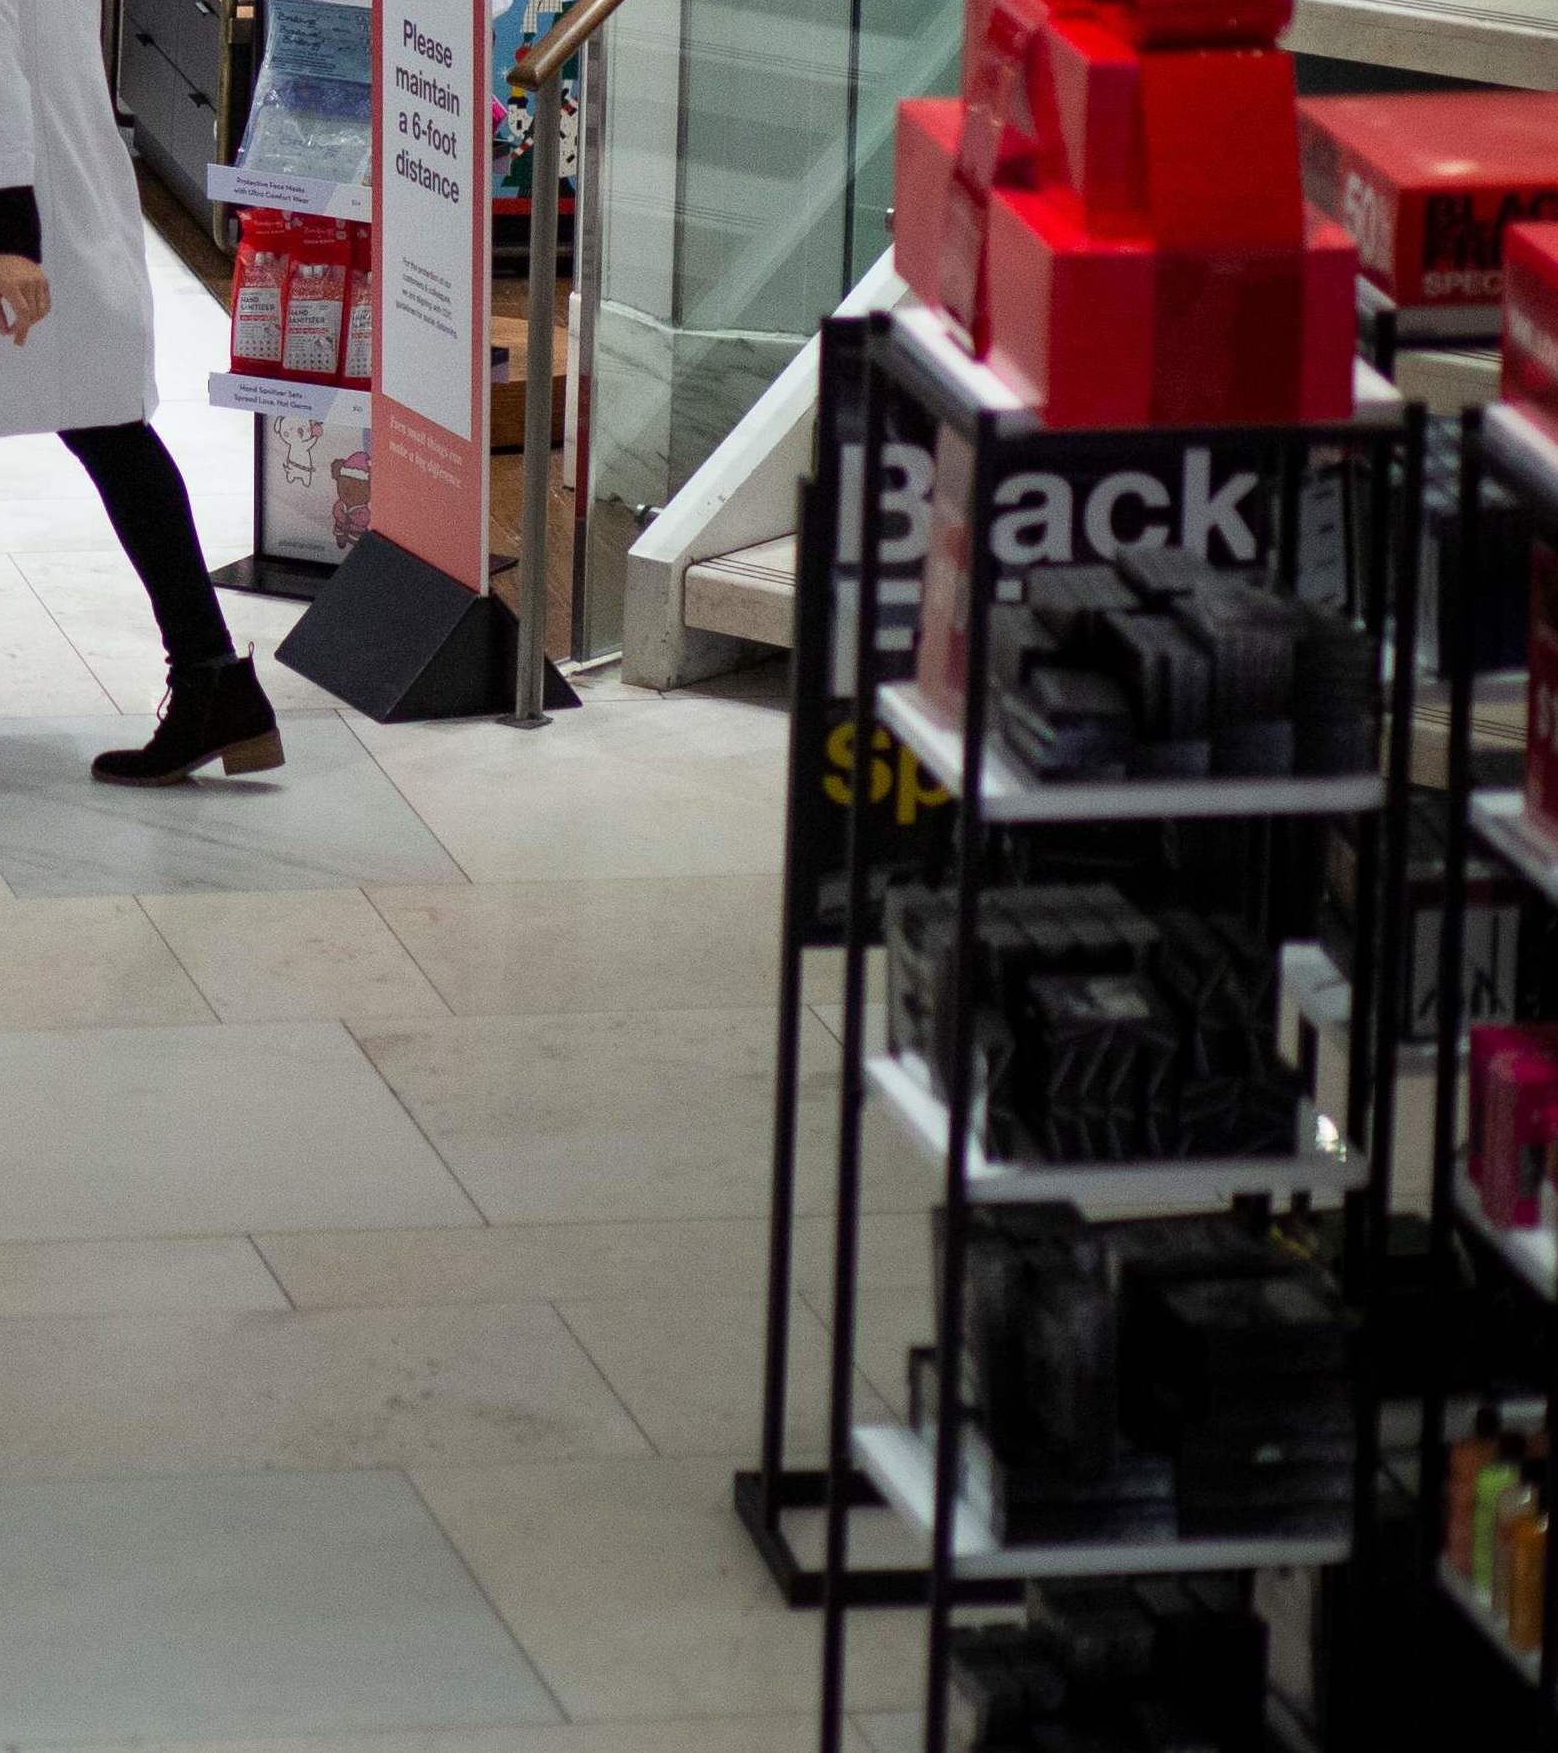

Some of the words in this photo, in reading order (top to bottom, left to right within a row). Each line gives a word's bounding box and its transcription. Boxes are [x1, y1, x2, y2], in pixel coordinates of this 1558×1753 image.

[403, 19, 452, 69] Please
[395, 65, 460, 117] maintain
[398, 111, 408, 135] a
[412, 111, 457, 160] 6-foot
[395, 148, 460, 204] distance
[836, 442, 1260, 566] Back
